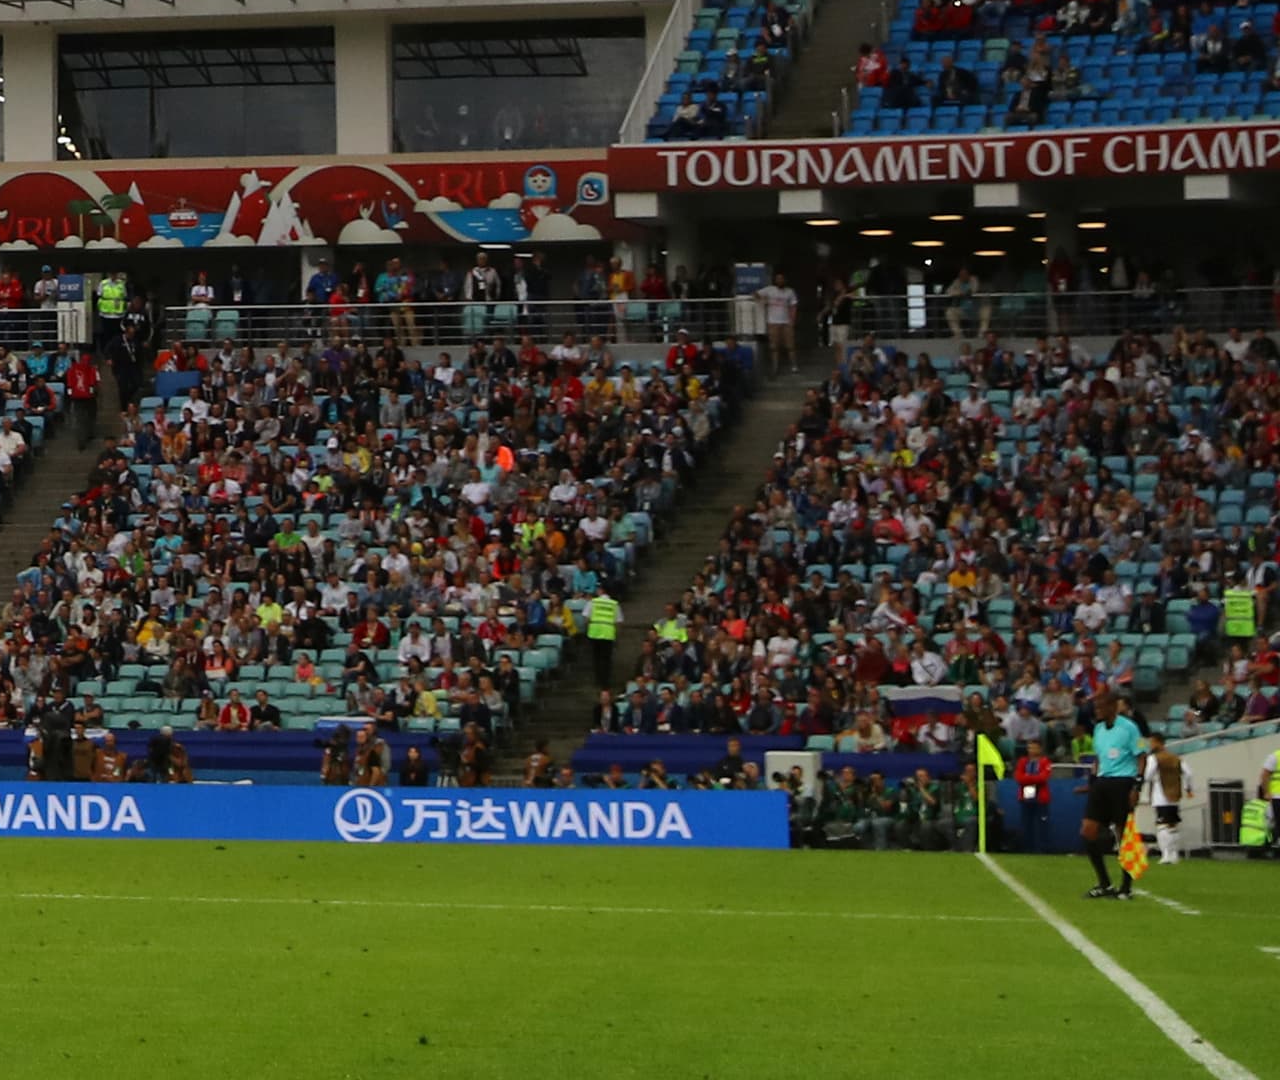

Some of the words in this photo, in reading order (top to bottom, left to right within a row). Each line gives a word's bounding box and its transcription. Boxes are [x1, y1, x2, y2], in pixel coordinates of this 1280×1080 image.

[657, 141, 1015, 186] TOURNAMENT
[1027, 137, 1091, 176] OF
[509, 801, 692, 839] WANDA
